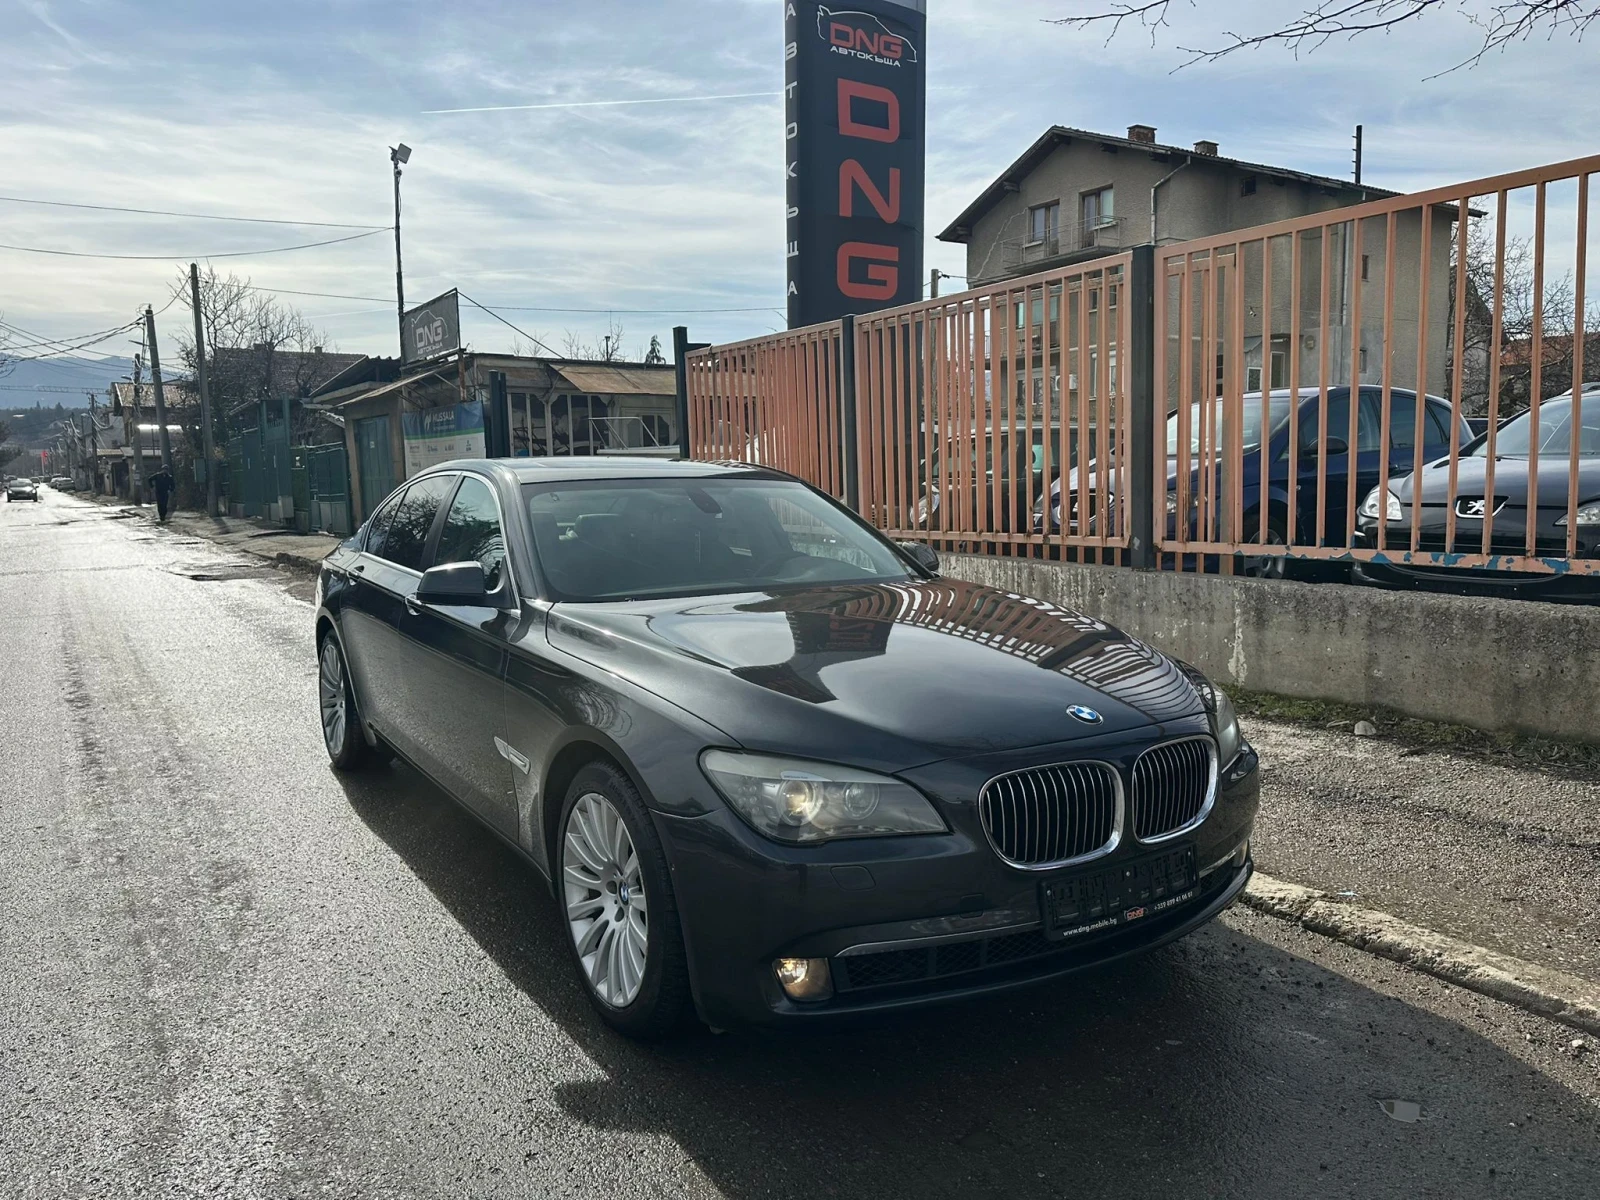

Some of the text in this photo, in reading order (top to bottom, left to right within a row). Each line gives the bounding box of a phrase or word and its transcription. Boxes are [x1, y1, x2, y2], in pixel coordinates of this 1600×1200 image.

[830, 22, 902, 59] DNG
[837, 78, 900, 301] DNG
[416, 320, 443, 348] DNG
[1063, 918, 1117, 936] www.dng.mobile.bg
